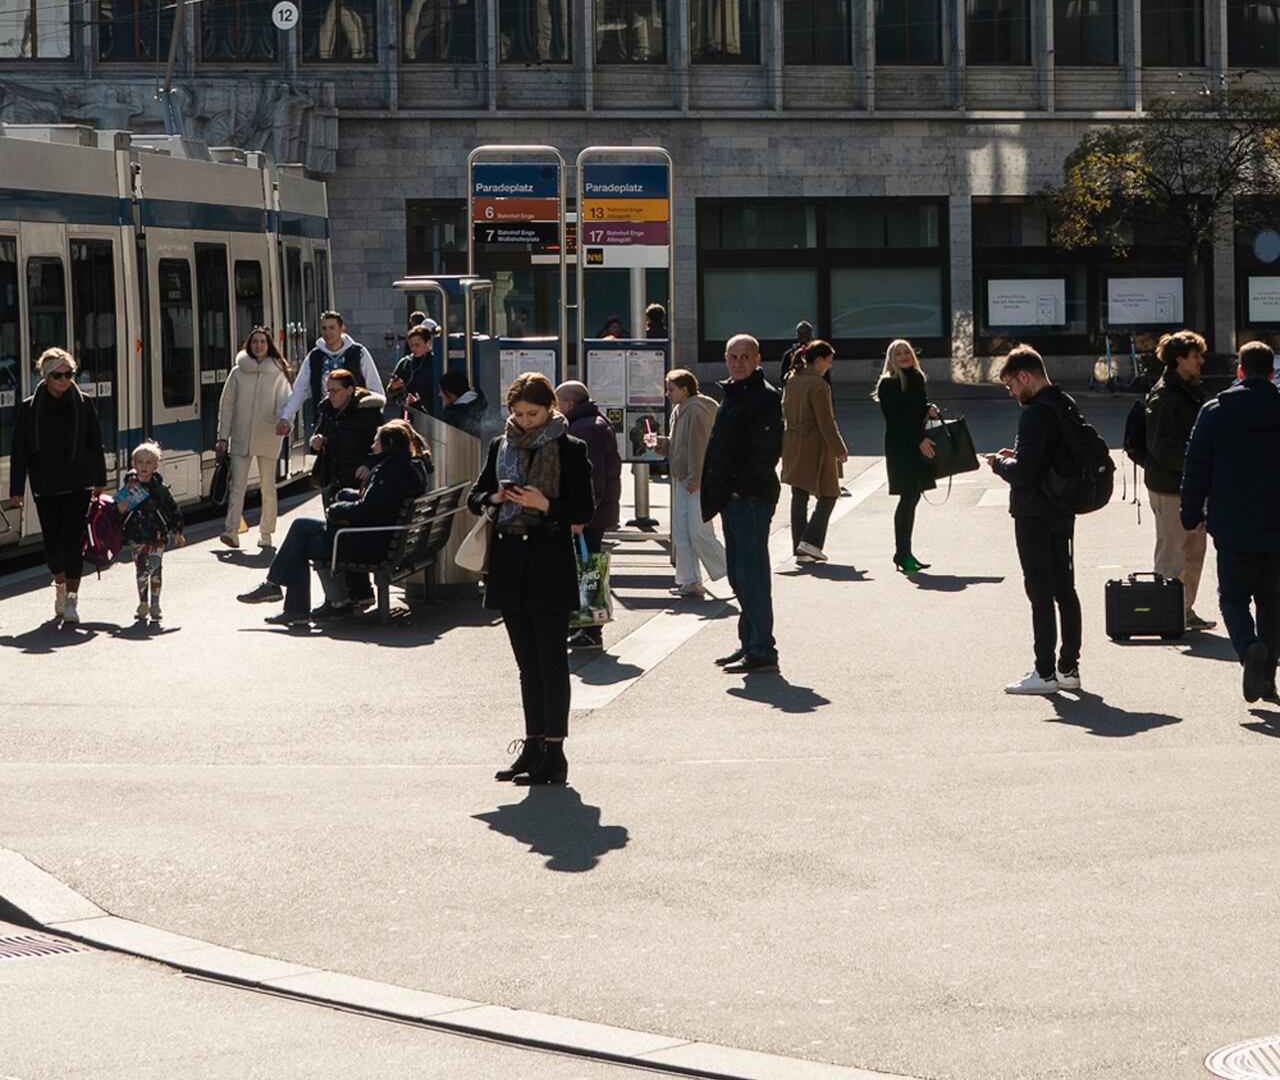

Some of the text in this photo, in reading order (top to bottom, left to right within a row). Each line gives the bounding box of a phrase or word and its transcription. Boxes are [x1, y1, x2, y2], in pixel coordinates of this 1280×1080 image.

[277, 9, 293, 22] 12
[475, 183, 534, 194] Paradeplatz
[585, 182, 644, 194] Paradeplatz
[484, 206, 495, 219] 6
[590, 207, 605, 219] 13
[485, 229, 495, 242] 7
[589, 230, 604, 243] 17
